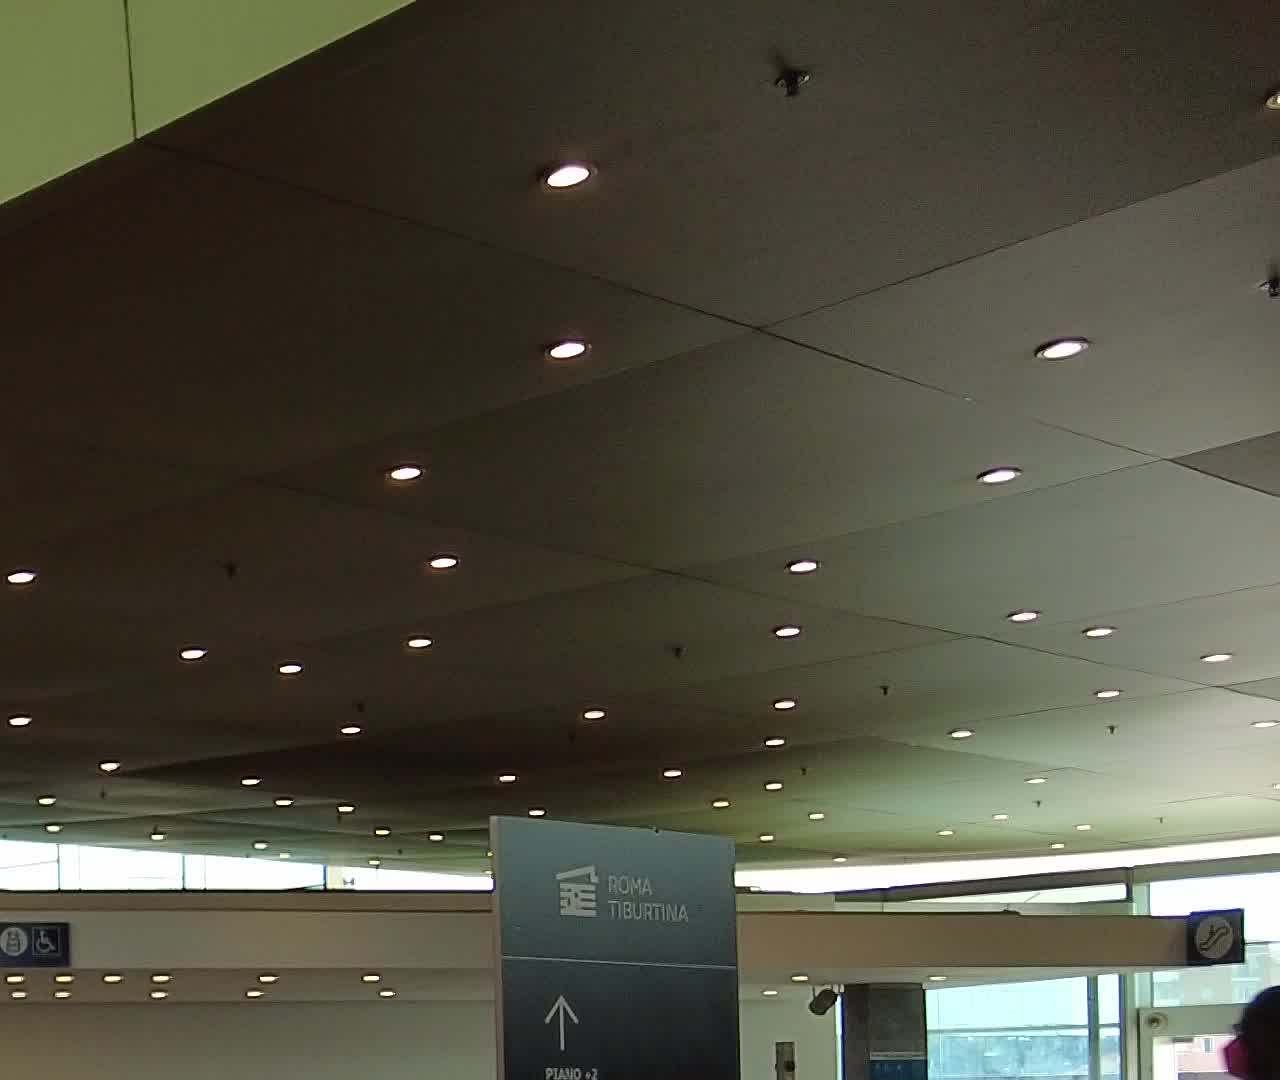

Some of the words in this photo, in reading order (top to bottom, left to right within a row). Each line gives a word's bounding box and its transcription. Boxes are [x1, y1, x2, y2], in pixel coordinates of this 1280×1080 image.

[608, 874, 654, 896] ROMA
[608, 900, 689, 922] TIBURTINA
[544, 1067, 582, 1080] PIANO
